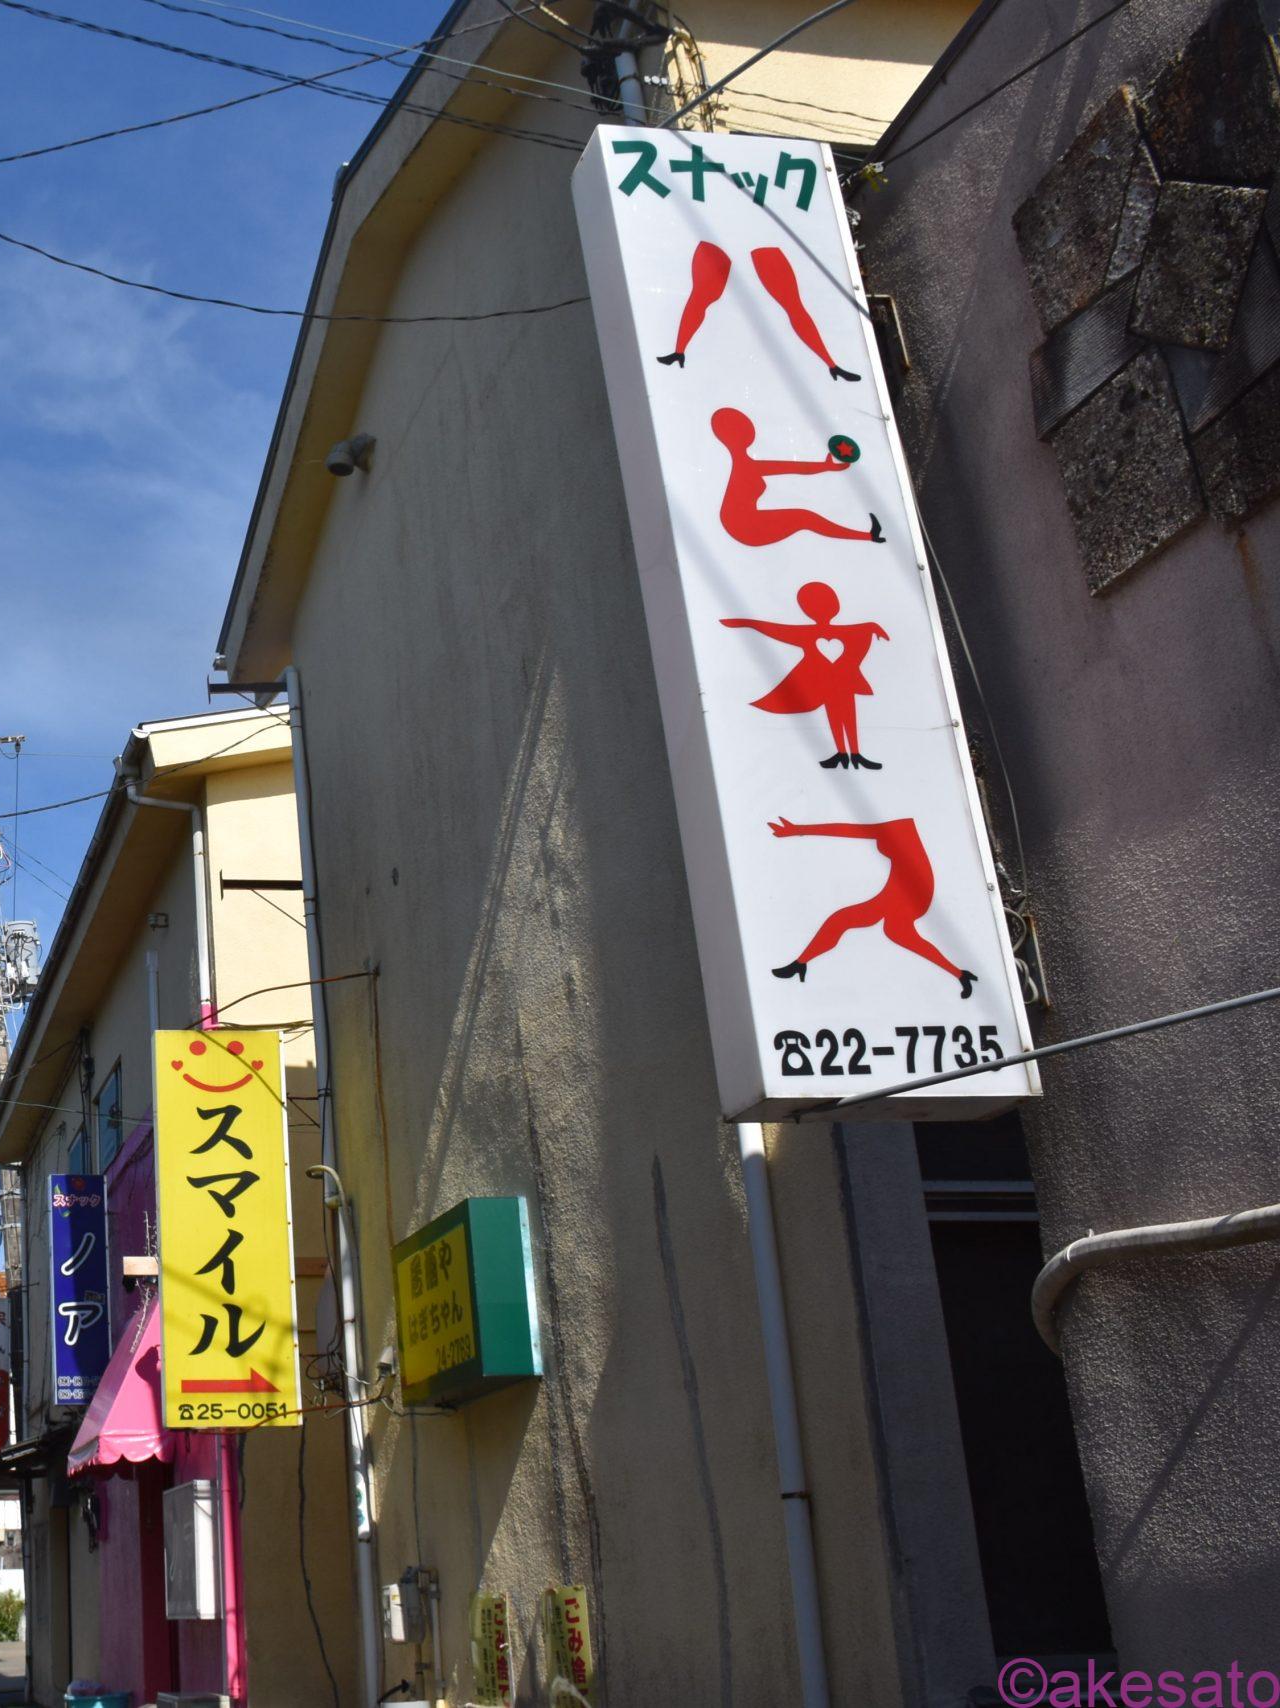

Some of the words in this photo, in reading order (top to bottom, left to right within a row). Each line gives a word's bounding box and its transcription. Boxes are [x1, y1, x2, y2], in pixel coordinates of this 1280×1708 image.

[611, 139, 818, 212] スナック
[814, 1025, 1004, 1076] 22-7735
[53, 1194, 101, 1207] スナック
[186, 1104, 266, 1358] スマイル
[58, 1232, 103, 1346] ノア
[196, 1402, 288, 1421] 25-0051
